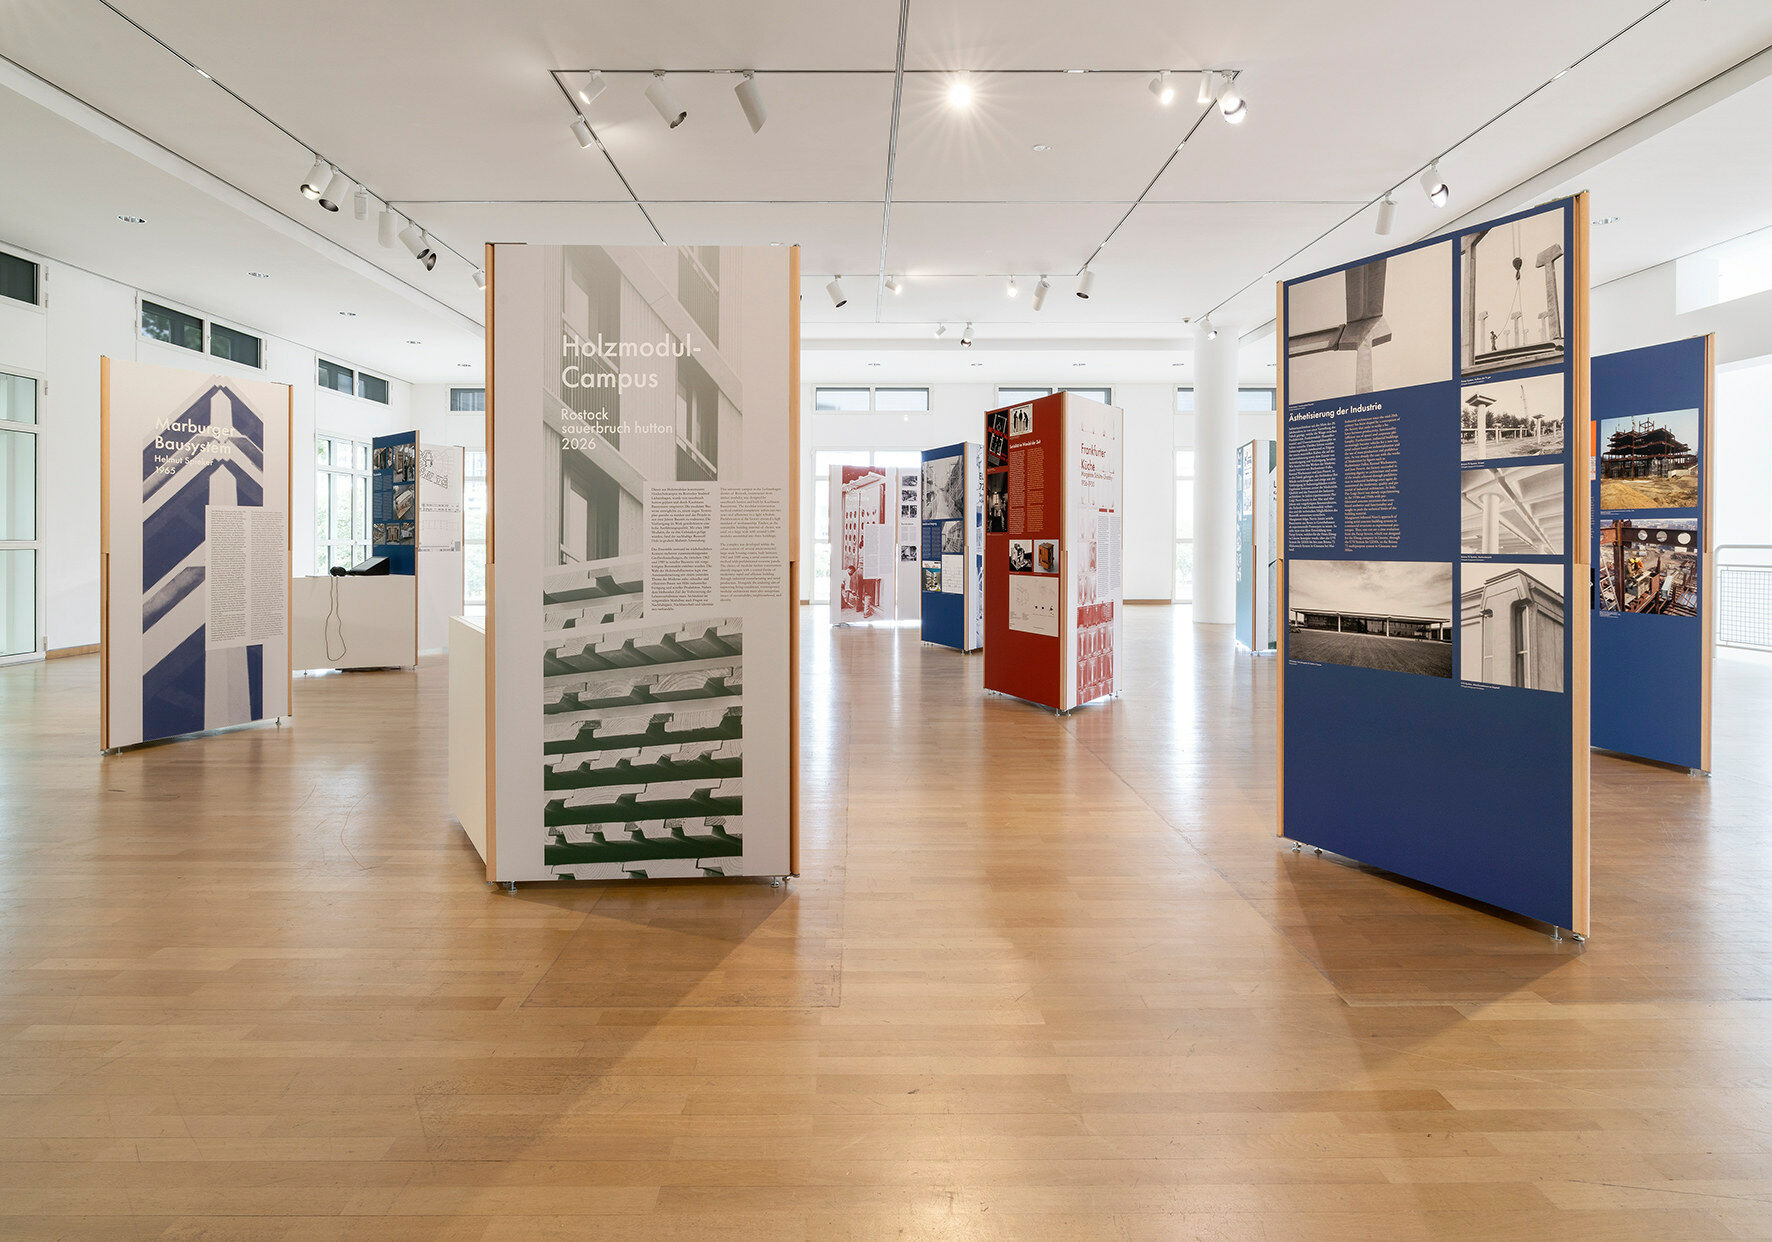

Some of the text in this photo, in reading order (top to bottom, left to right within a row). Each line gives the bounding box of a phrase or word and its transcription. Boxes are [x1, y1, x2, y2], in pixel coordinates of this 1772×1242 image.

[562, 333, 702, 357] Holzmodul-
[561, 365, 659, 394] Campus
[561, 407, 609, 420] Rostock
[1288, 402, 1382, 422] Ästhetisierung der Industrie
[155, 415, 236, 439] Marburger
[561, 421, 673, 434] sauerbruch hutton
[155, 435, 231, 456] Bausystem
[561, 438, 597, 450] 2026
[154, 454, 183, 465] Helmut
[1081, 459, 1095, 472] Küche
[155, 466, 176, 475] 1965
